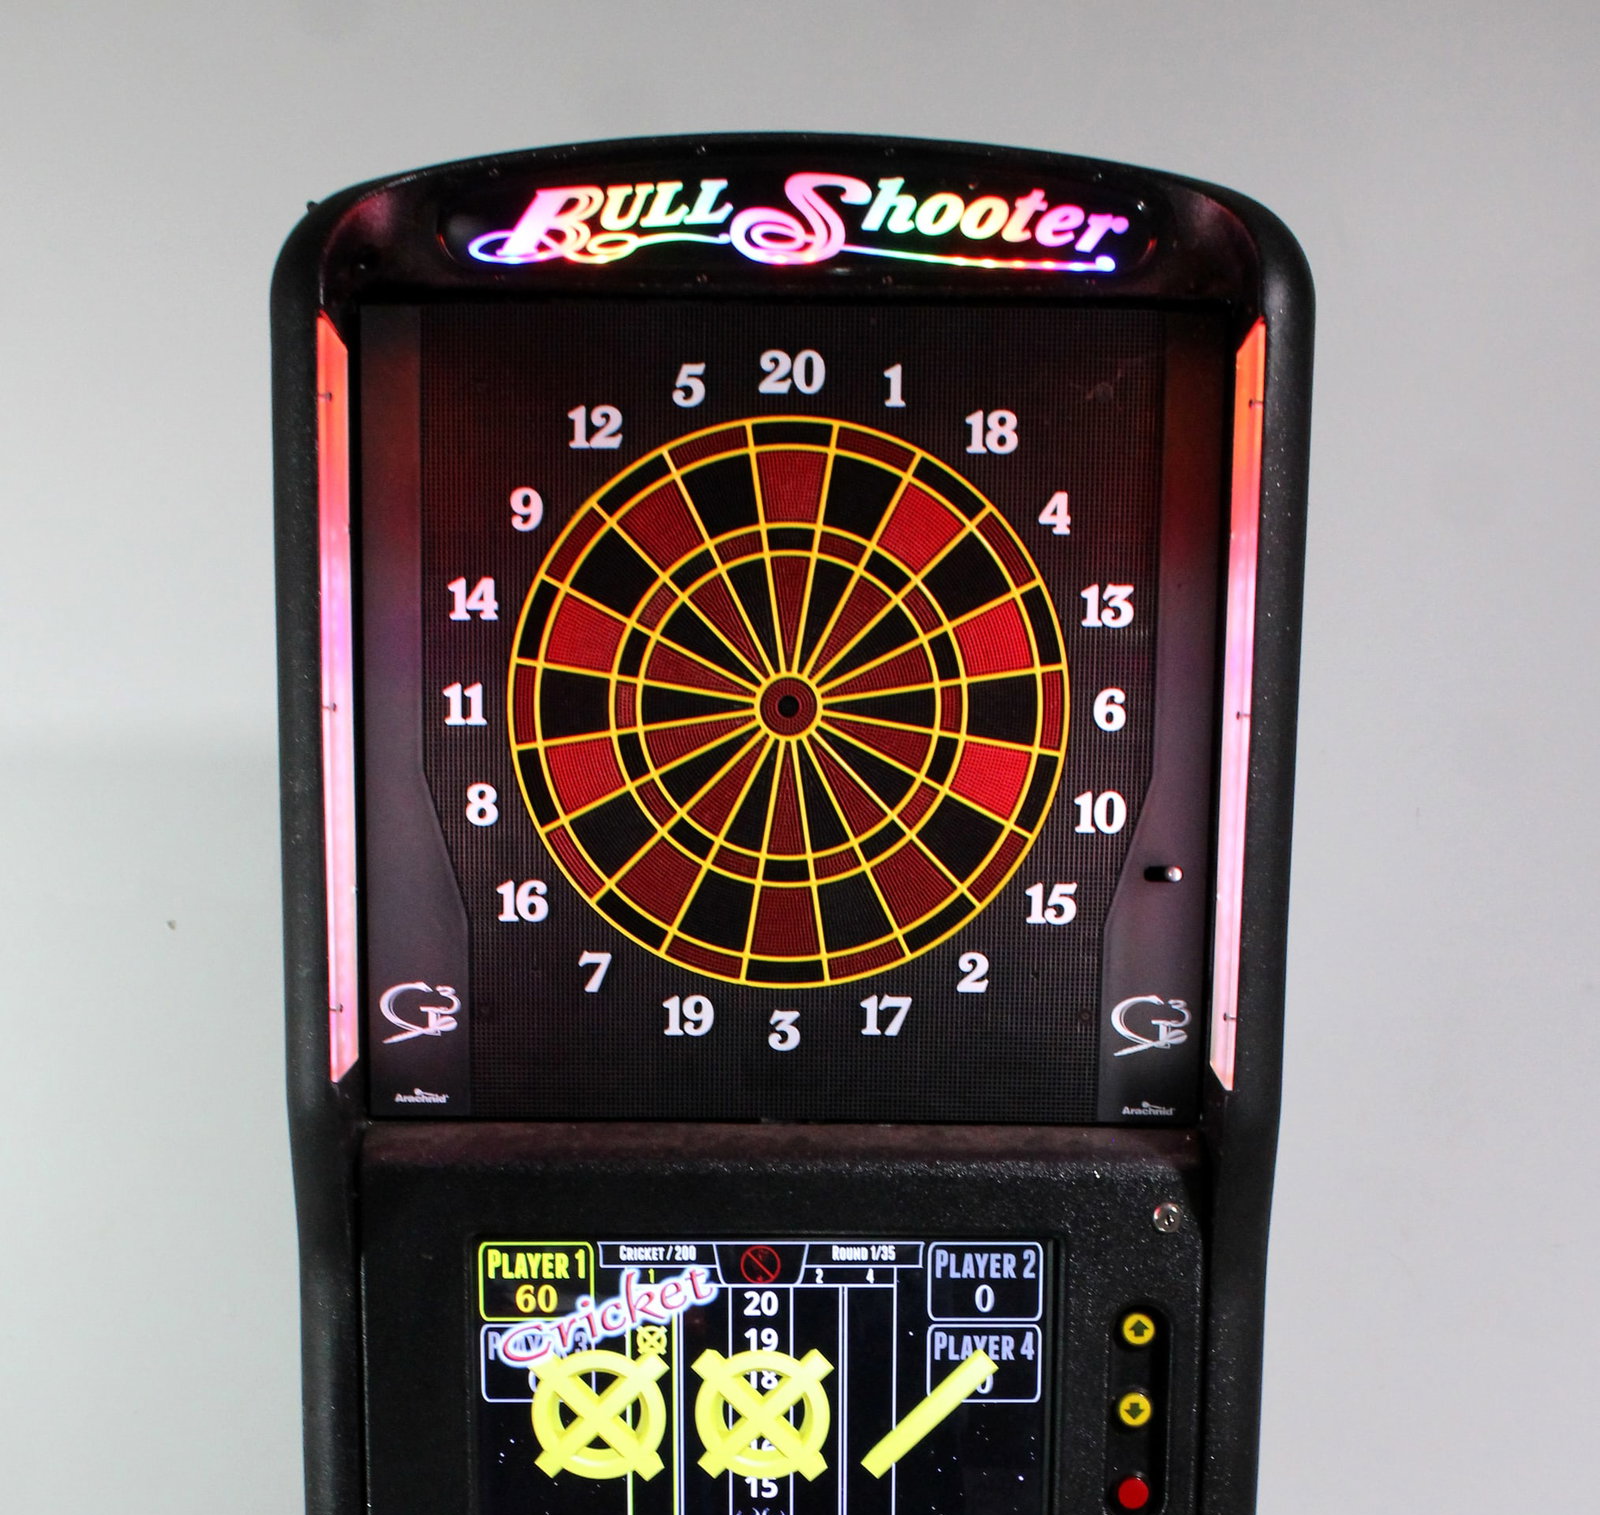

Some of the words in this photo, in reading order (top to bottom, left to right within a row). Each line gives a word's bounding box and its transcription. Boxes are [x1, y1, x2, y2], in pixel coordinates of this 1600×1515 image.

[729, 172, 1129, 265] Shooter
[672, 363, 706, 407] 5
[758, 350, 826, 394] 20
[883, 364, 906, 407] 1
[568, 405, 623, 448] 12
[965, 410, 1019, 454] 18
[510, 488, 543, 532] 9
[1038, 492, 1071, 535] 4
[447, 577, 499, 621] 14
[1080, 584, 1134, 629] 13
[442, 682, 488, 726] 11
[1093, 688, 1126, 732] 6
[465, 783, 499, 827] 8
[1073, 790, 1127, 835] 10
[496, 879, 549, 922] 16
[1025, 882, 1078, 925] 15
[578, 950, 612, 993] 7
[956, 951, 989, 993] 2
[662, 995, 715, 1037] 19
[768, 1009, 801, 1051] 3
[860, 994, 913, 1036] 17
[574, 1249, 586, 1280] 1
[674, 1245, 697, 1261] 200
[869, 1245, 896, 1261] 1/35
[1022, 1249, 1036, 1279] 2
[648, 1268, 655, 1284] 1
[815, 1268, 824, 1284] 2
[865, 1268, 875, 1284] 4
[500, 1266, 717, 1365] Cricket
[515, 1284, 559, 1313] 60
[743, 1290, 779, 1316] 20
[974, 1284, 996, 1313] 0
[743, 1327, 779, 1351] 19
[1019, 1331, 1035, 1361] 4
[744, 1476, 779, 1499] 15
